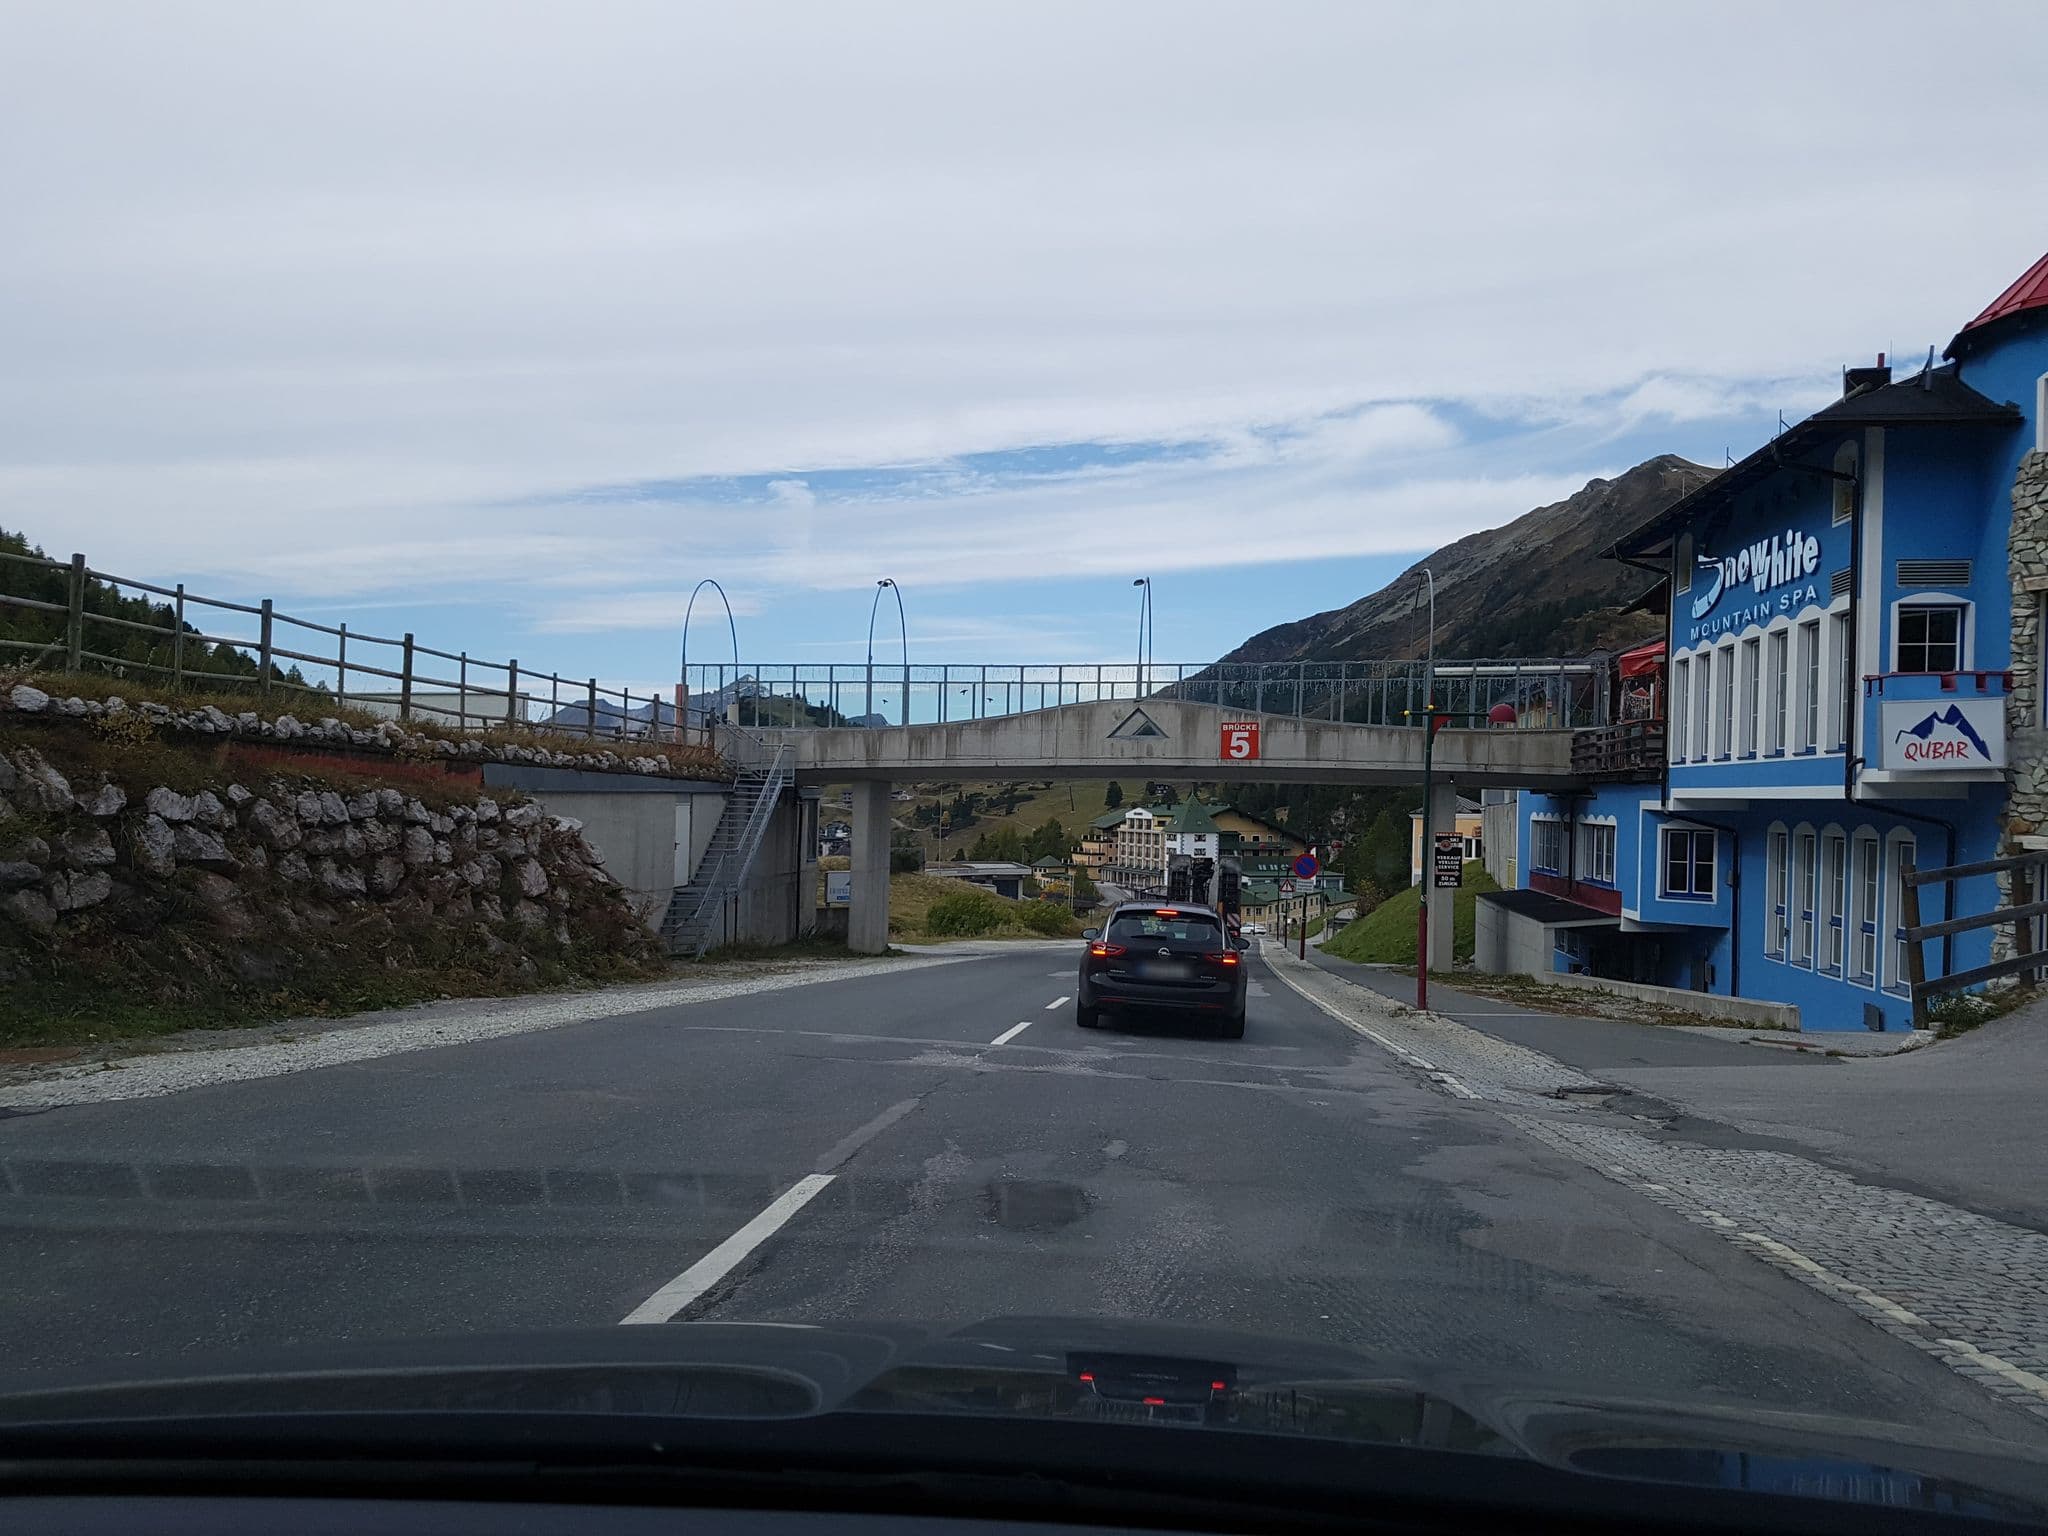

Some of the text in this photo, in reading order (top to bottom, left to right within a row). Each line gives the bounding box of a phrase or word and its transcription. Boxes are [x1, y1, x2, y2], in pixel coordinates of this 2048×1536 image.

[1690, 585, 1817, 640] MOUNTAIN SPA
[1229, 731, 1250, 758] 5
[1904, 740, 1970, 762] QUBAR
